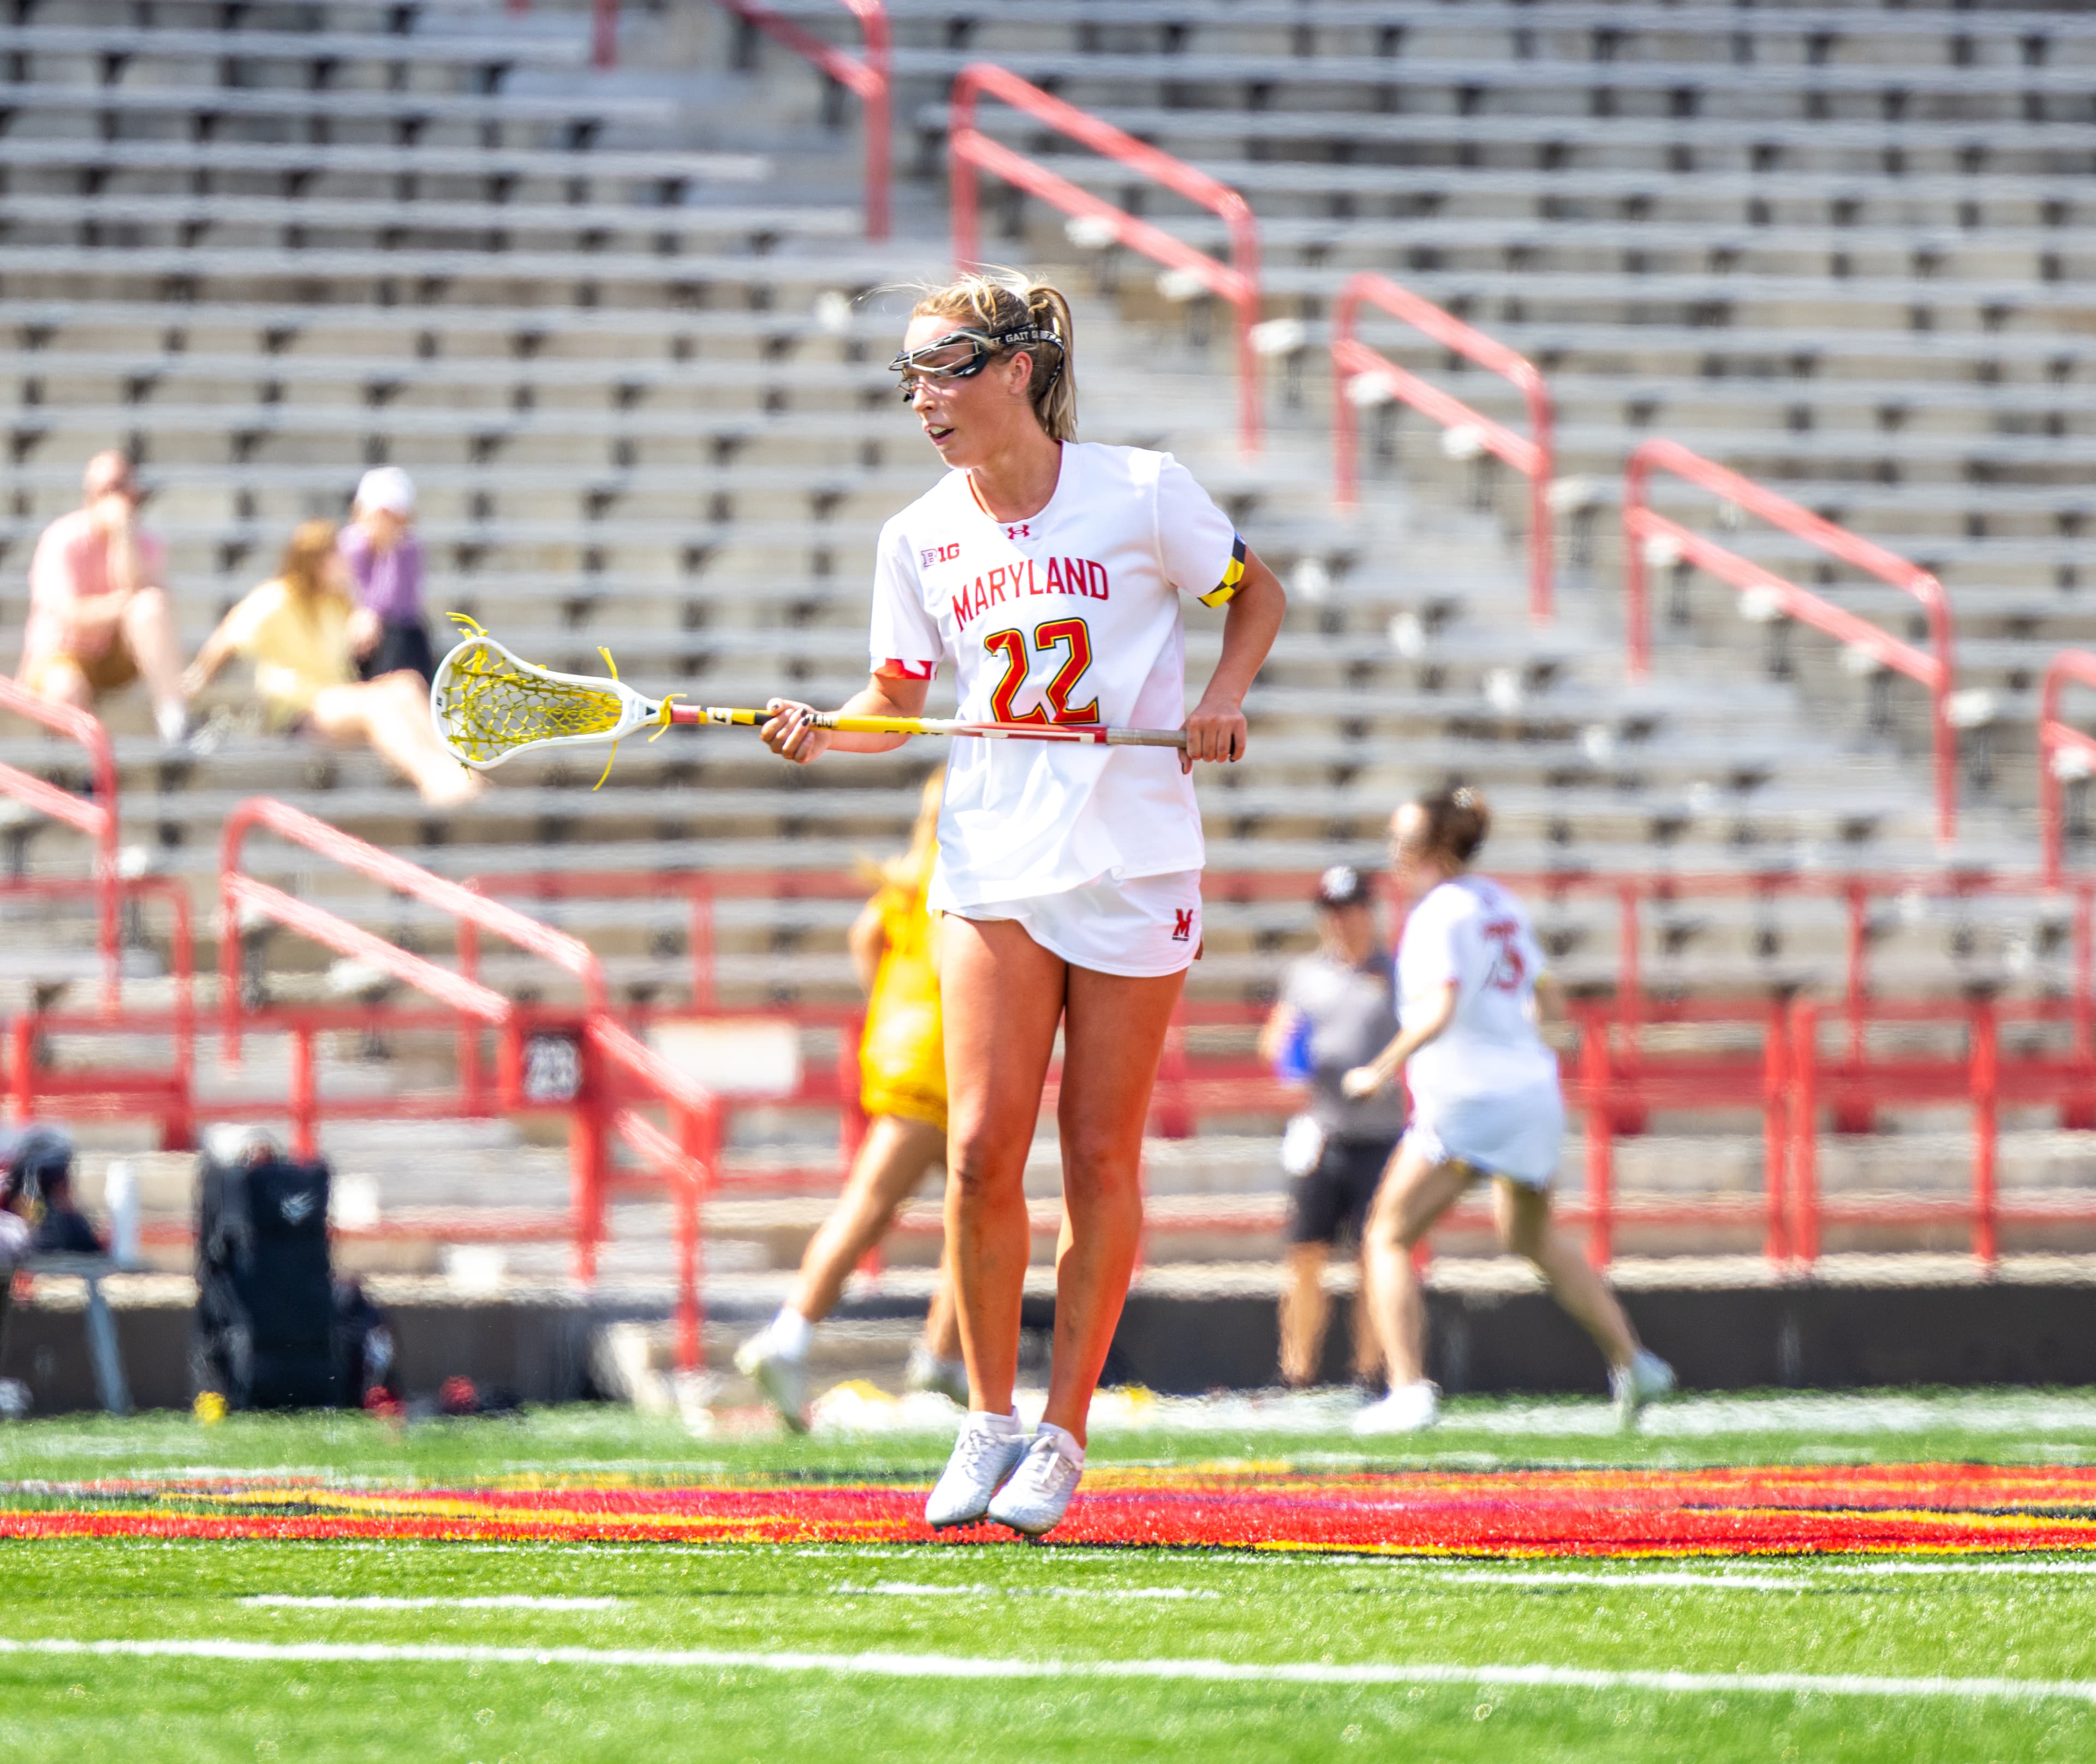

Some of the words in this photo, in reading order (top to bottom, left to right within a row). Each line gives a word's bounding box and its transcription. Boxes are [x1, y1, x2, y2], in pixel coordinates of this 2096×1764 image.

[1005, 331, 1028, 342] GAIT
[951, 556, 1109, 633] MARYLAND
[984, 616, 1100, 726] 22
[1172, 908, 1194, 938] M
